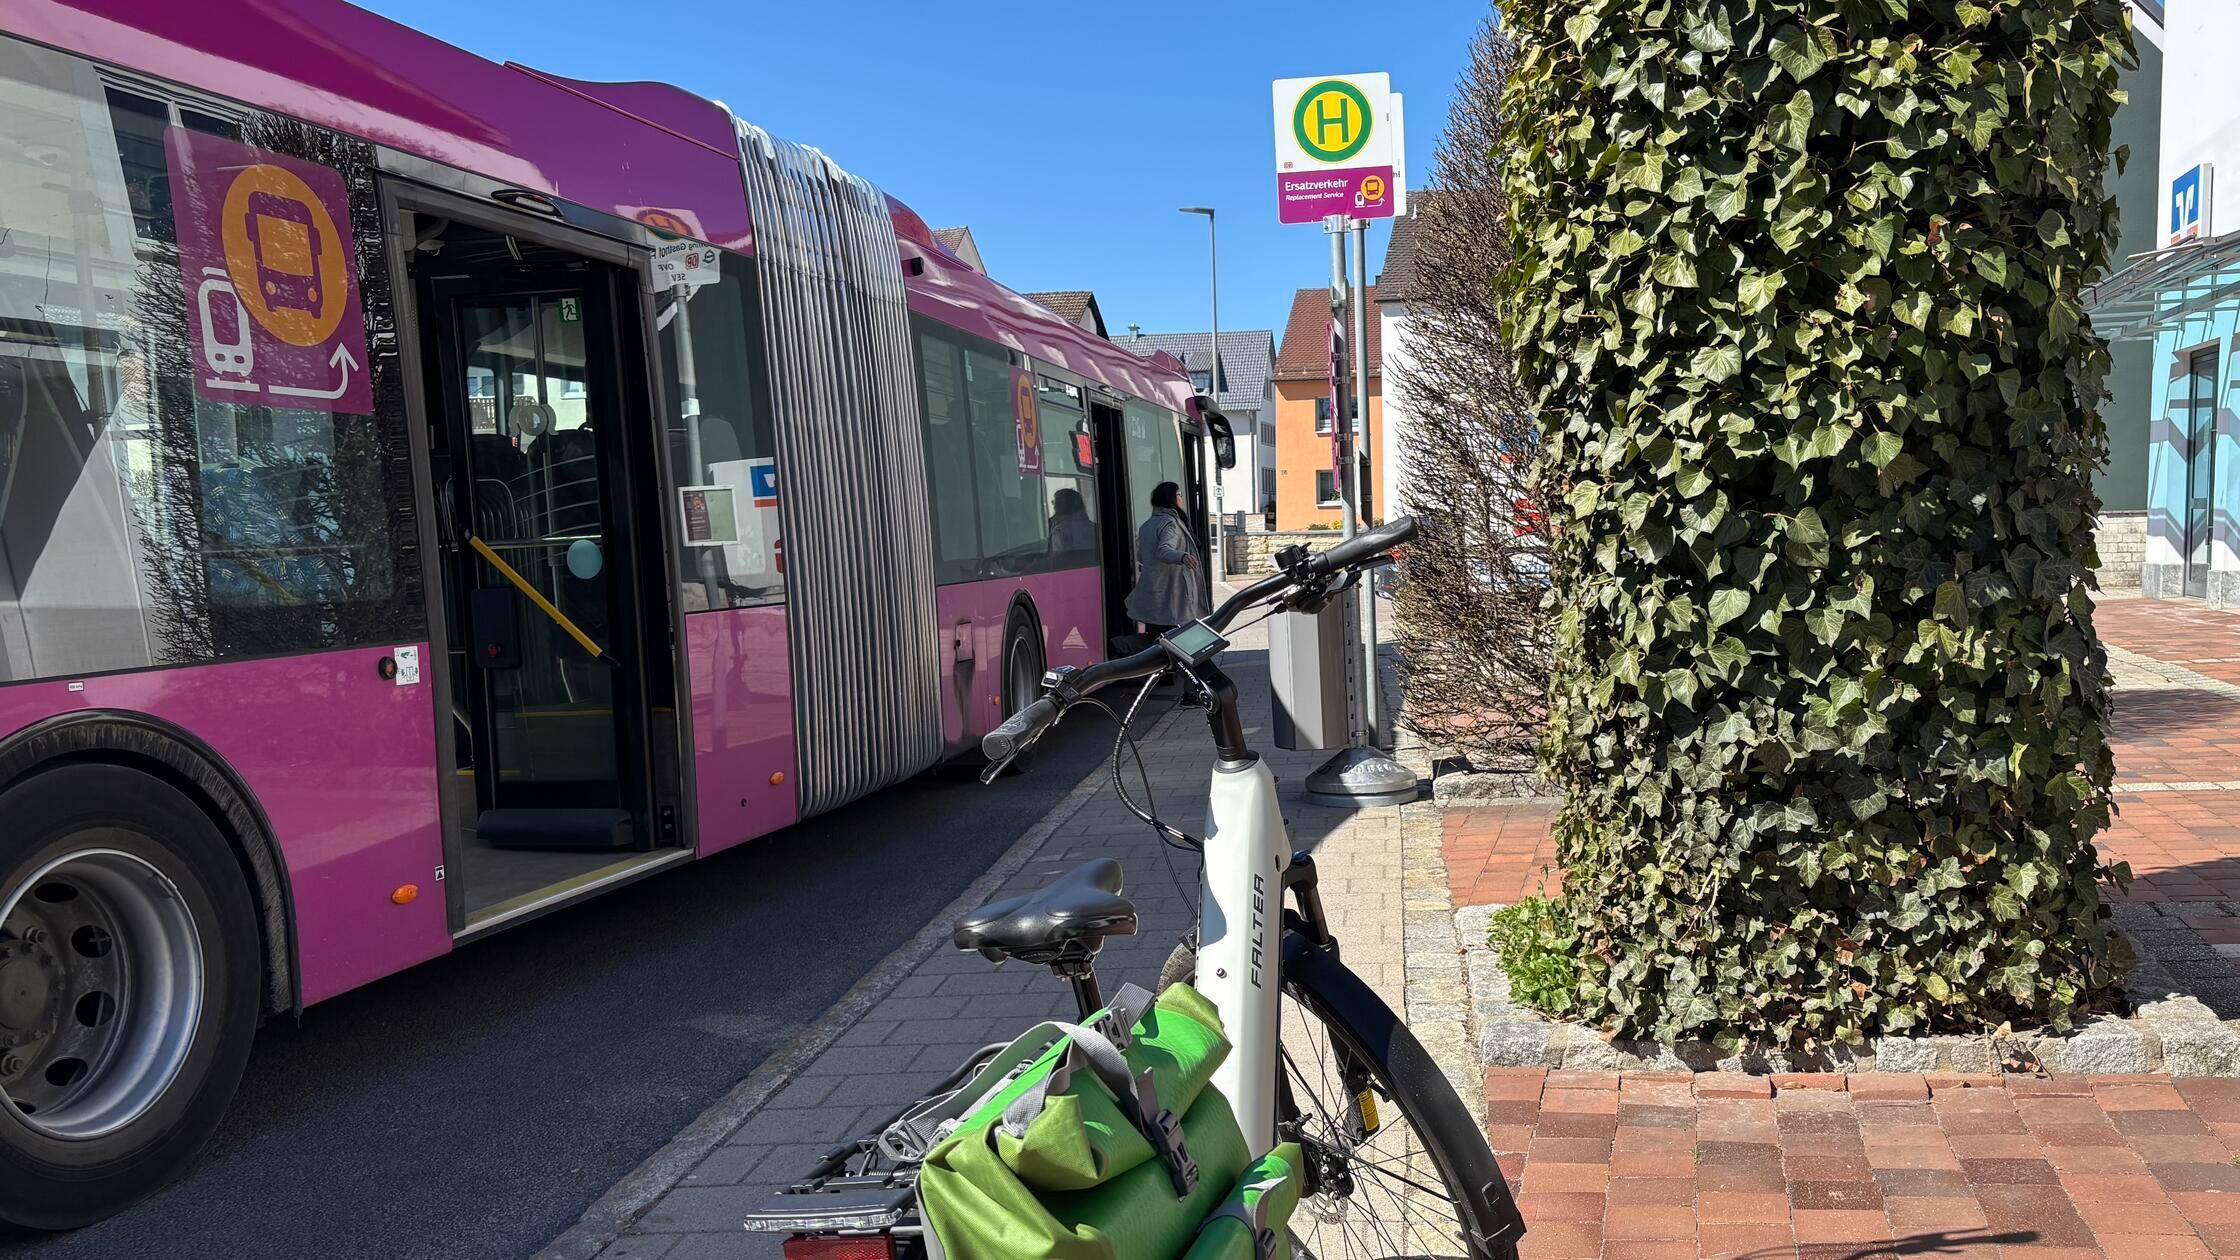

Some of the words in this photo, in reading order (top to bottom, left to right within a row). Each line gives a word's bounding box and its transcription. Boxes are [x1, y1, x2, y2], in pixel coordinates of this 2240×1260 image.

[1316, 98, 1349, 144] H
[1285, 179, 1348, 191] Ersatzverkehr
[1286, 193, 1322, 201] Replacement
[1251, 873, 1264, 989] FALTER
